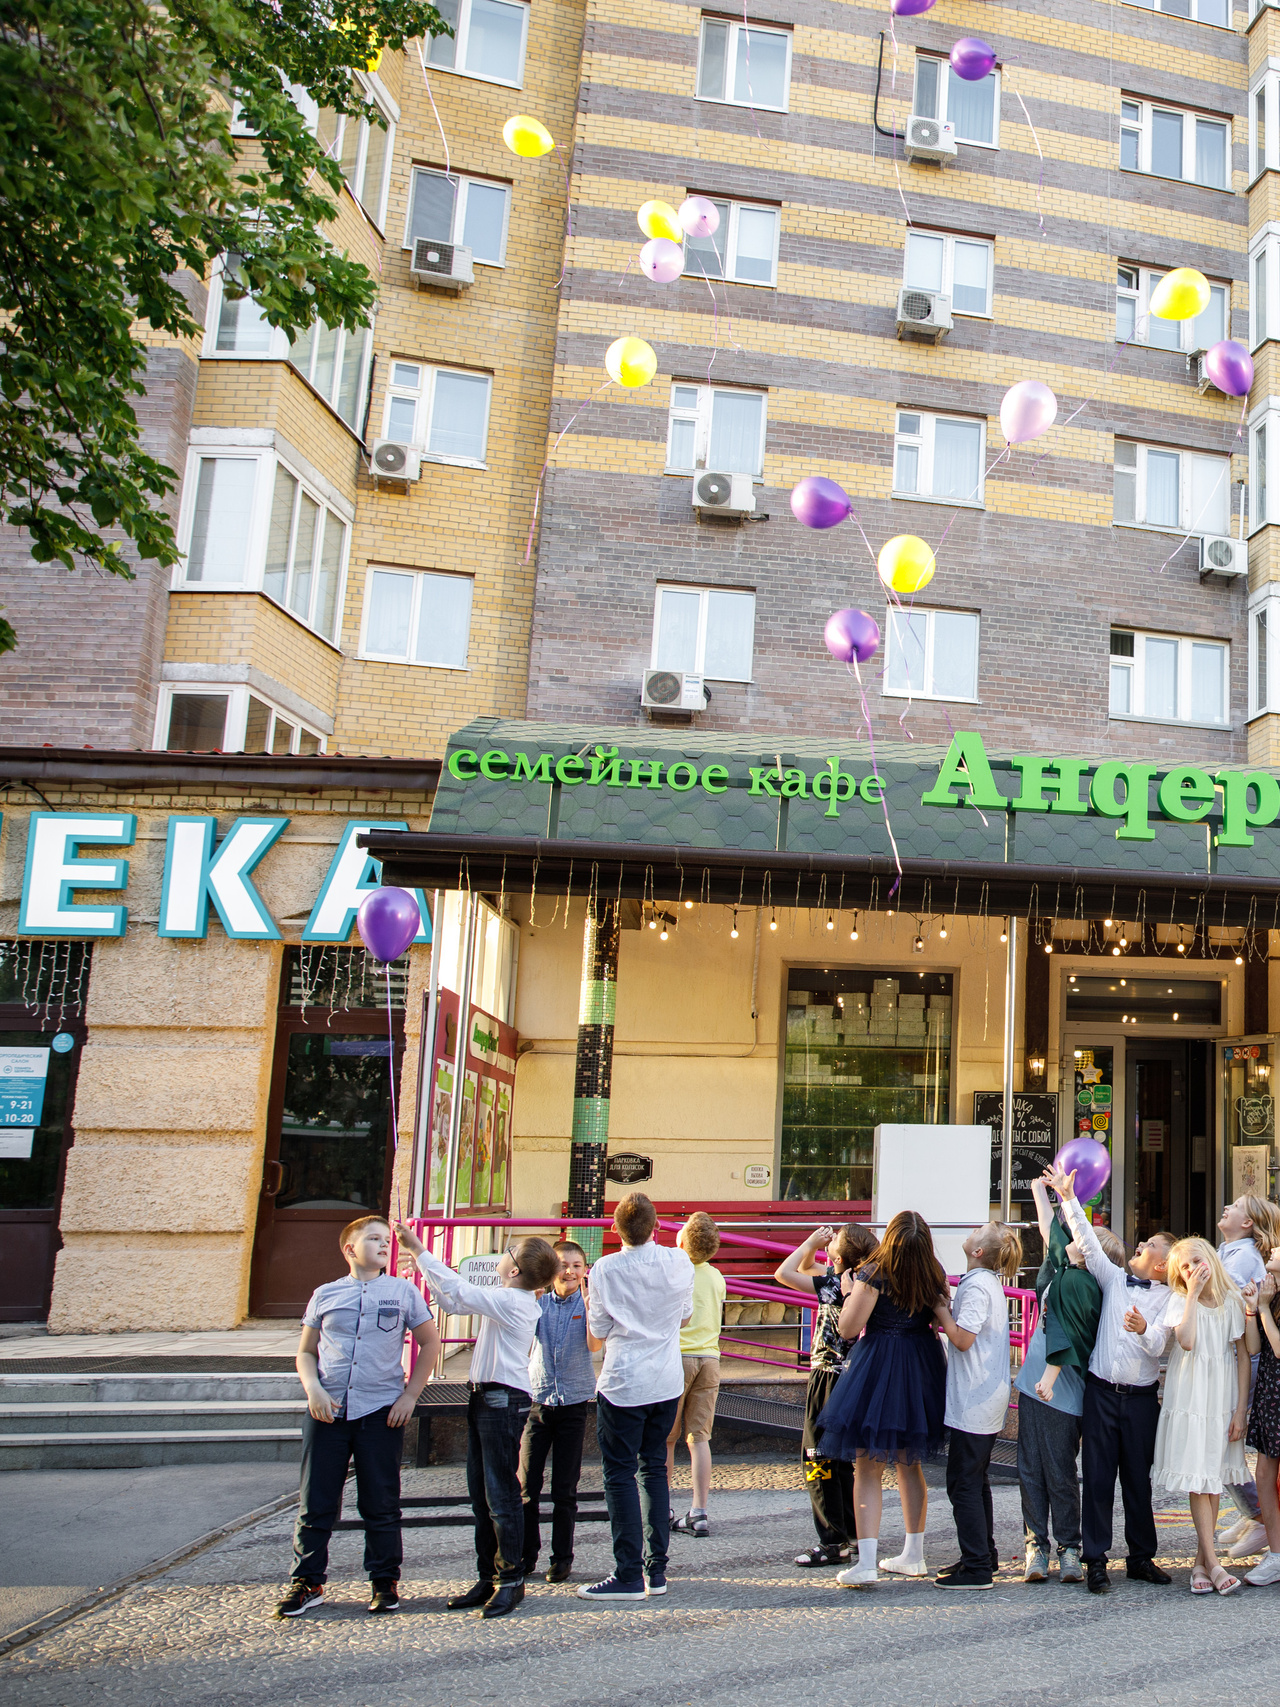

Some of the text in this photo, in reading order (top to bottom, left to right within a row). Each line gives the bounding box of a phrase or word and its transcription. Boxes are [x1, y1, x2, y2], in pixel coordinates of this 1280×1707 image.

[447, 745, 888, 818] семейное кафе
[0, 810, 433, 943] ЕКА
[10, 1100, 32, 1110] 9-21
[5, 1113, 34, 1123] 10-20
[1028, 1128, 1051, 1144] СОБОЙ
[378, 1299, 400, 1307] UNIQUE
